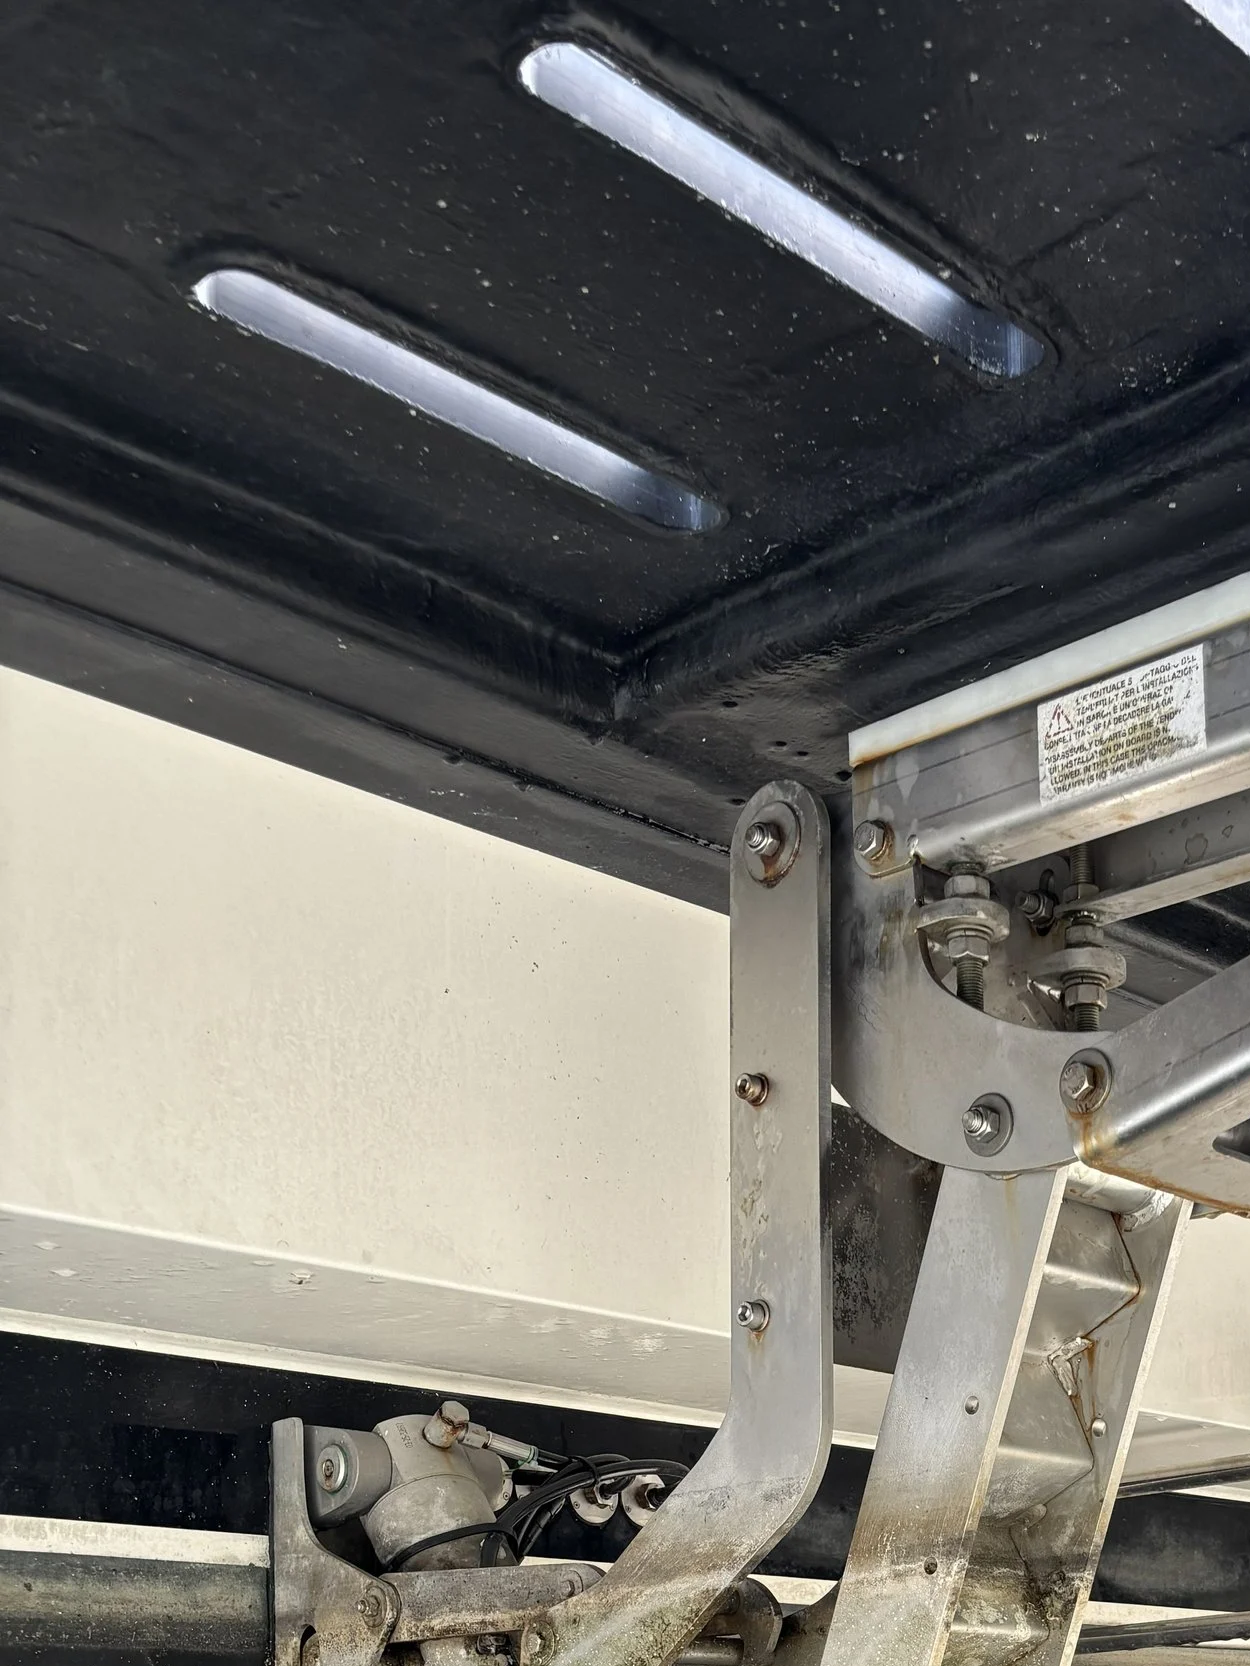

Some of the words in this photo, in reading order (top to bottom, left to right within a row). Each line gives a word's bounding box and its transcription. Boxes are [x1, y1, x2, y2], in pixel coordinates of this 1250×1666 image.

[1076, 717, 1084, 727] IN
[1114, 704, 1150, 725] DECADERE
[1151, 701, 1159, 711] LA
[1128, 724, 1137, 735] OF
[1139, 718, 1153, 730] THE
[1113, 740, 1123, 752] ON
[1126, 730, 1152, 747] BOARD
[1153, 727, 1160, 737] IS
[1093, 757, 1108, 771] THIS
[1110, 750, 1129, 765] CASE
